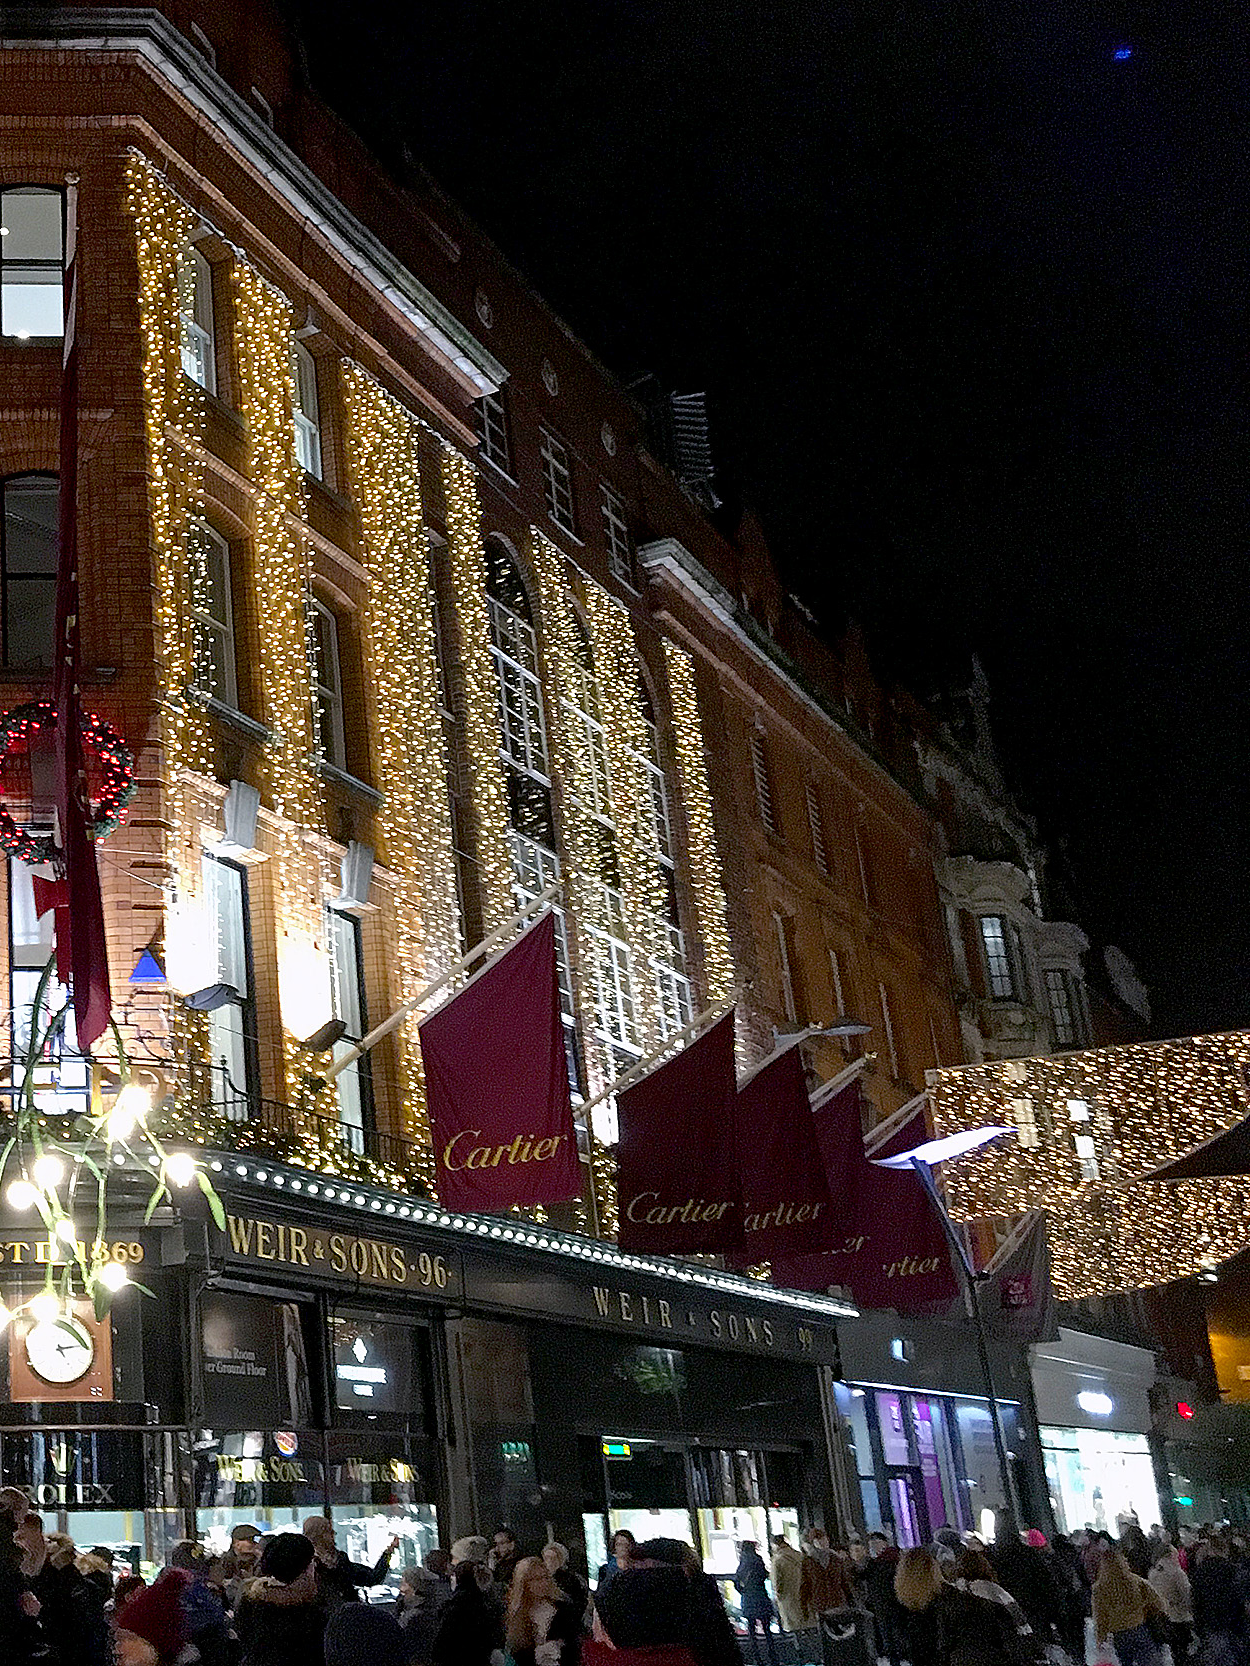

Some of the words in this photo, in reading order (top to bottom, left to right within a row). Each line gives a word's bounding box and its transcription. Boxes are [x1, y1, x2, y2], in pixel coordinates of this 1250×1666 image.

[442, 1129, 568, 1172] Cartier
[626, 1192, 735, 1225] Cartier
[743, 1201, 827, 1233] artier
[227, 1214, 310, 1267] WEIR
[313, 1239, 325, 1260] &
[329, 1234, 407, 1284] SONS
[592, 1285, 673, 1330] WEIR
[710, 1309, 774, 1347] SONS
